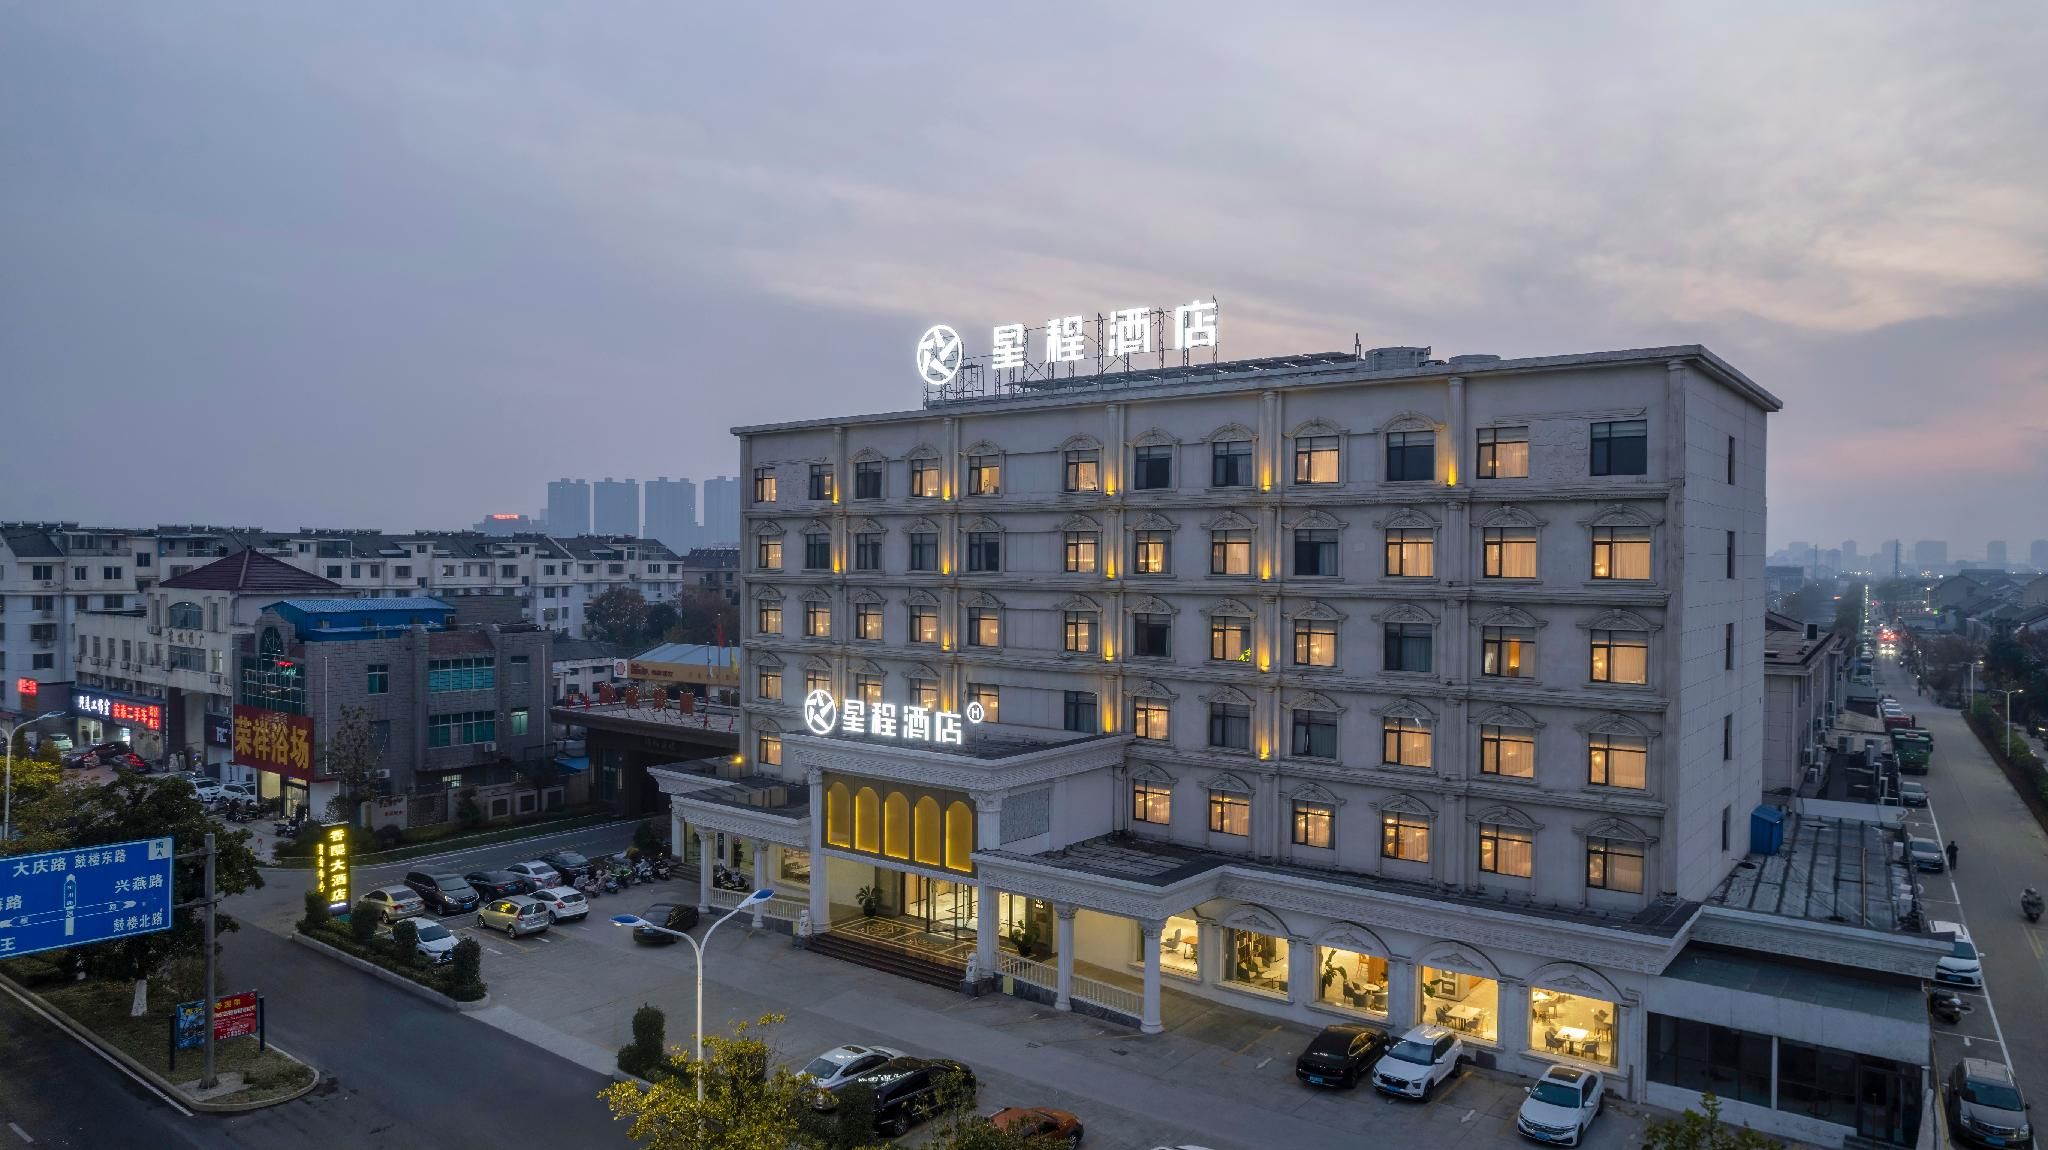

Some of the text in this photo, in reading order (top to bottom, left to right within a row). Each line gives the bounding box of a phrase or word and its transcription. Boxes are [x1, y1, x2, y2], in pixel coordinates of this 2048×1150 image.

[992, 300, 1217, 370] 星程酒店
[842, 699, 962, 745] 星程酒店
[235, 715, 310, 769] 荣祥浴场
[13, 849, 127, 878] 大庆路 鼓楼东路
[114, 873, 164, 894] 兴燕路
[113, 911, 163, 933] 鼓楼北路
